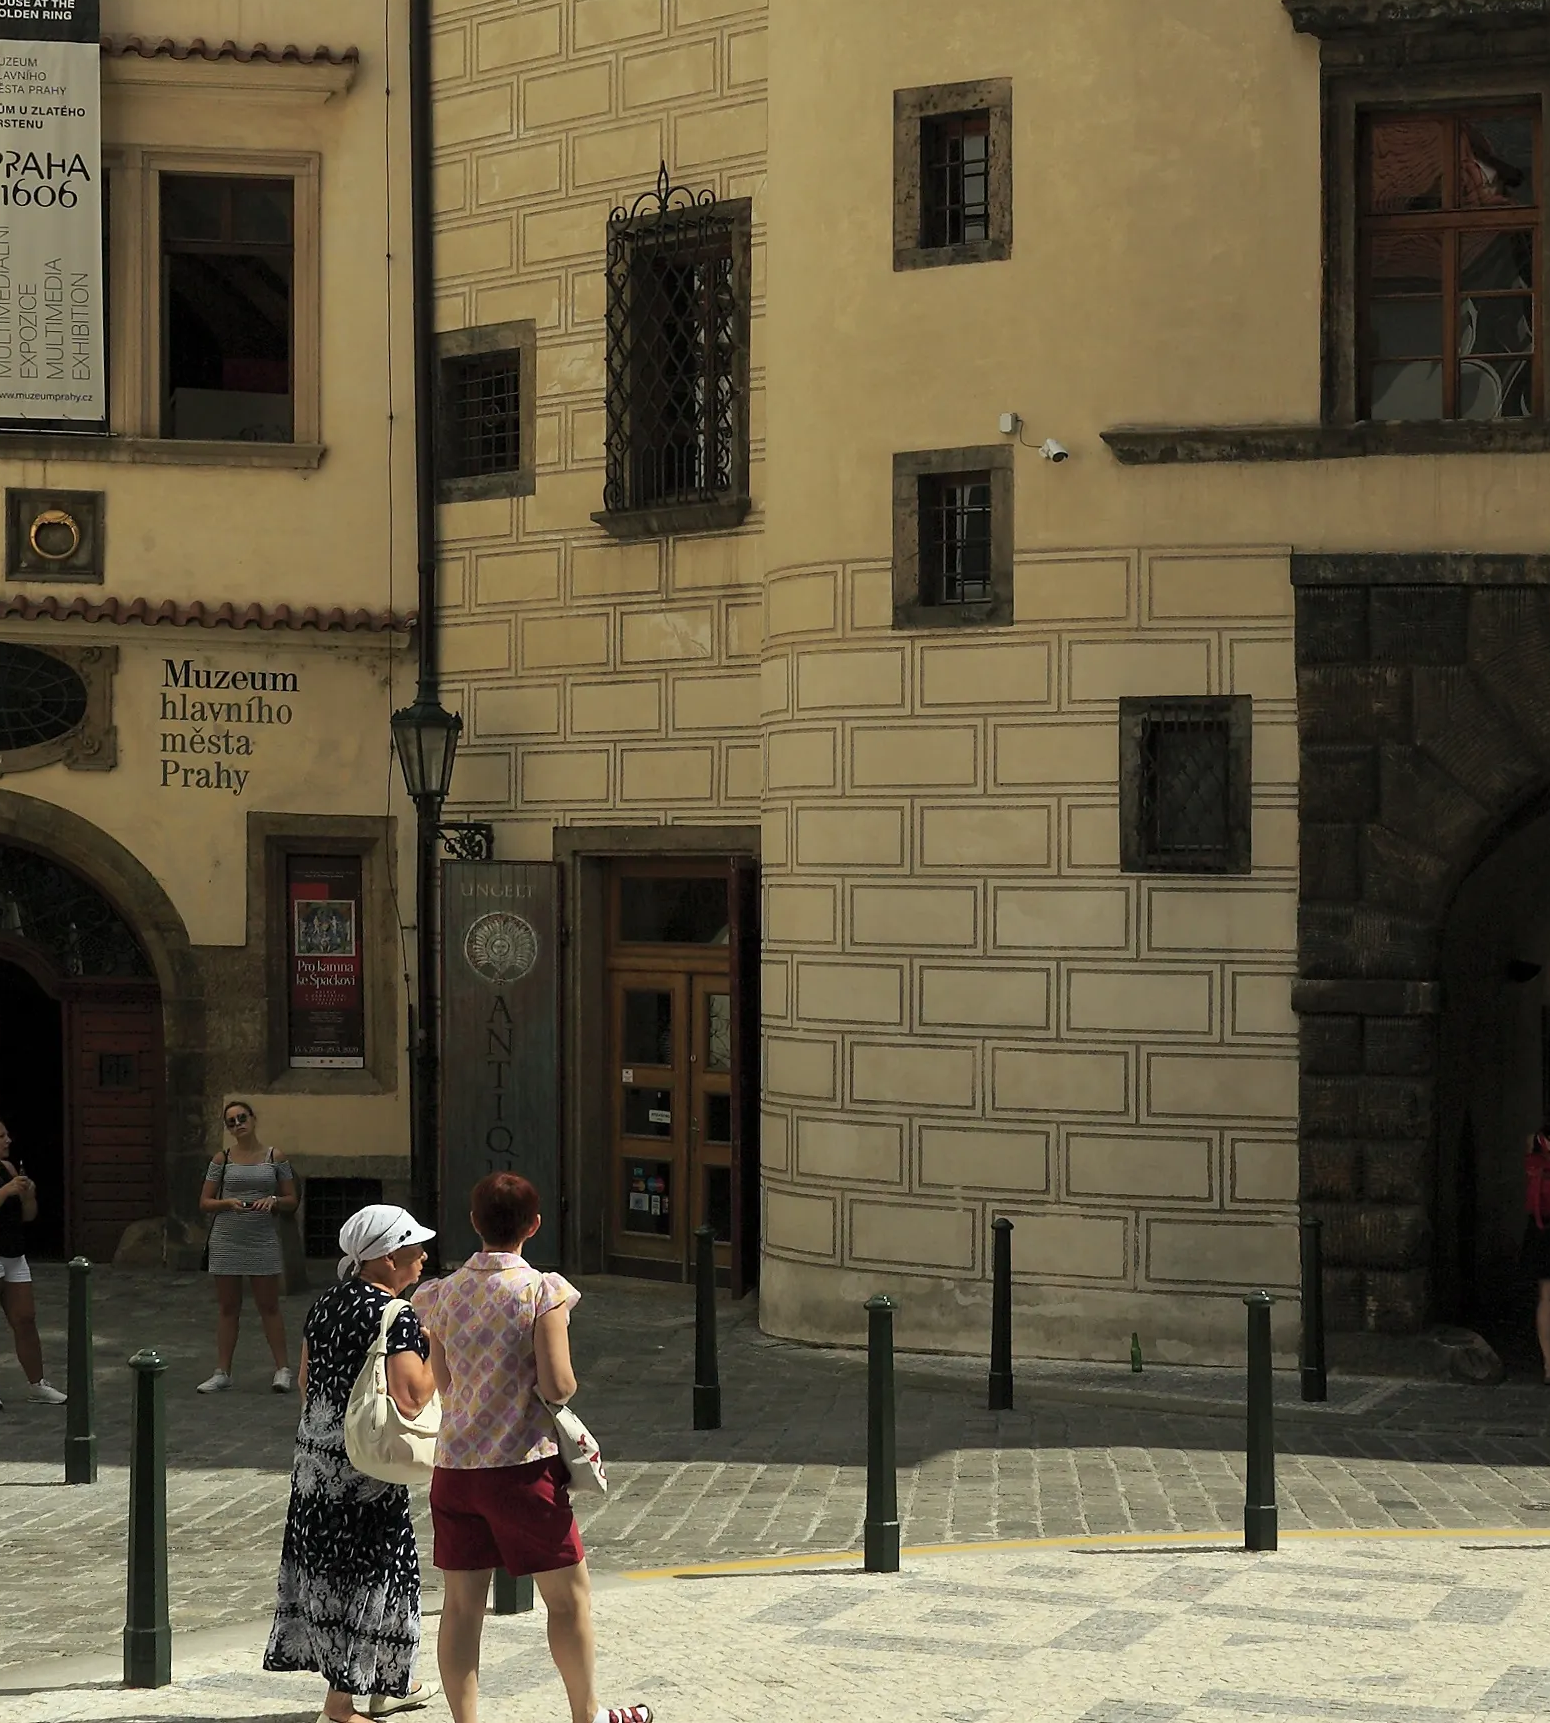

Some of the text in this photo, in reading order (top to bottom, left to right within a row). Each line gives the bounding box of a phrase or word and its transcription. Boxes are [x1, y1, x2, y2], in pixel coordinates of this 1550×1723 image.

[43, 9, 73, 21] RING
[28, 85, 67, 96] PRAHY
[19, 106, 28, 116] U
[31, 104, 86, 117] ZLATÉHO
[0, 180, 78, 208] 1606
[18, 283, 39, 380] EXPOZICE
[44, 257, 64, 380] MULTIMEDIA
[70, 272, 91, 381] EXHIBITION
[162, 658, 299, 692] Muzeum
[160, 693, 292, 725] hlavního
[160, 726, 253, 756] města
[160, 759, 250, 796] Prahy
[461, 882, 534, 899] UNGELT
[296, 973, 309, 986] ke
[297, 959, 354, 975] Pro kamna
